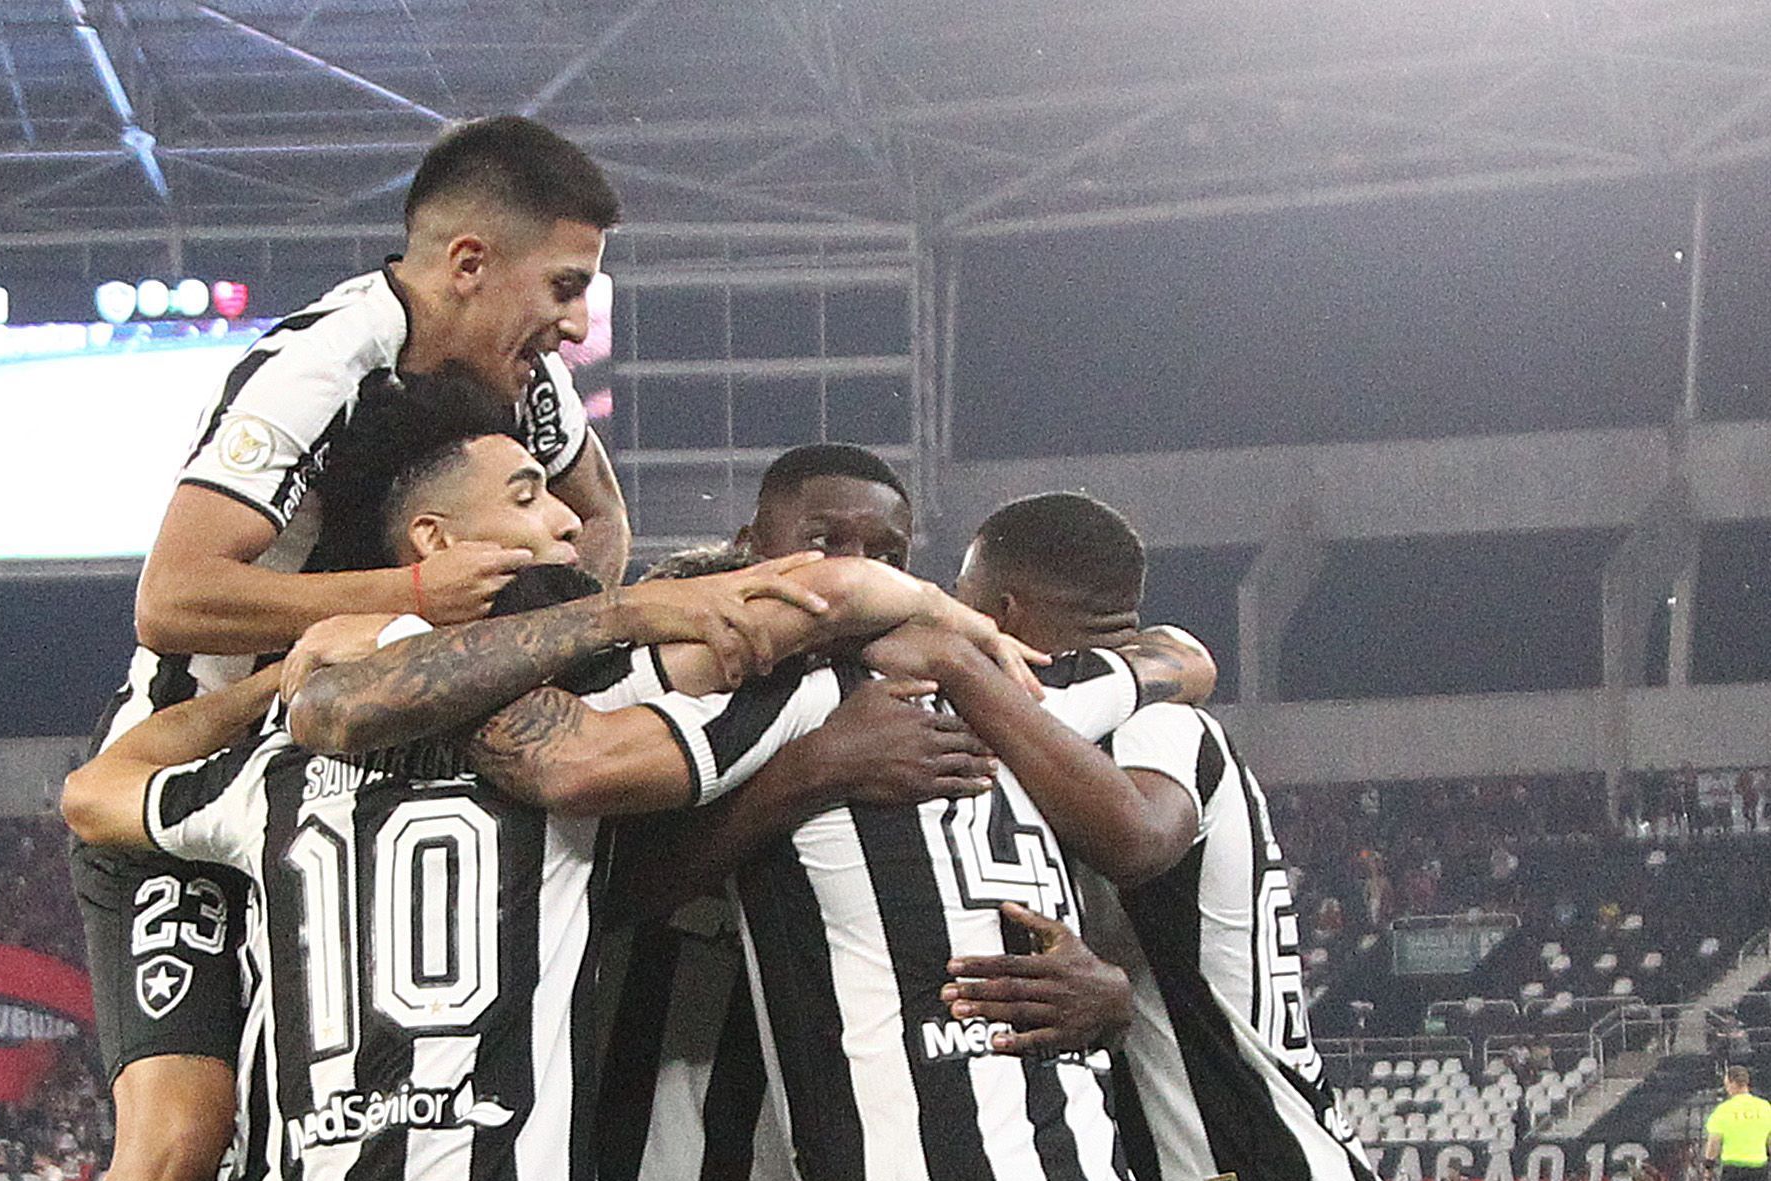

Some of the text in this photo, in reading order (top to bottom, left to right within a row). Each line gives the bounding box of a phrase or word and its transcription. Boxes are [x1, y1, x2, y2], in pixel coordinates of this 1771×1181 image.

[132, 874, 227, 956] 23
[284, 796, 500, 1058] 10
[288, 1080, 449, 1162] MedSênior
